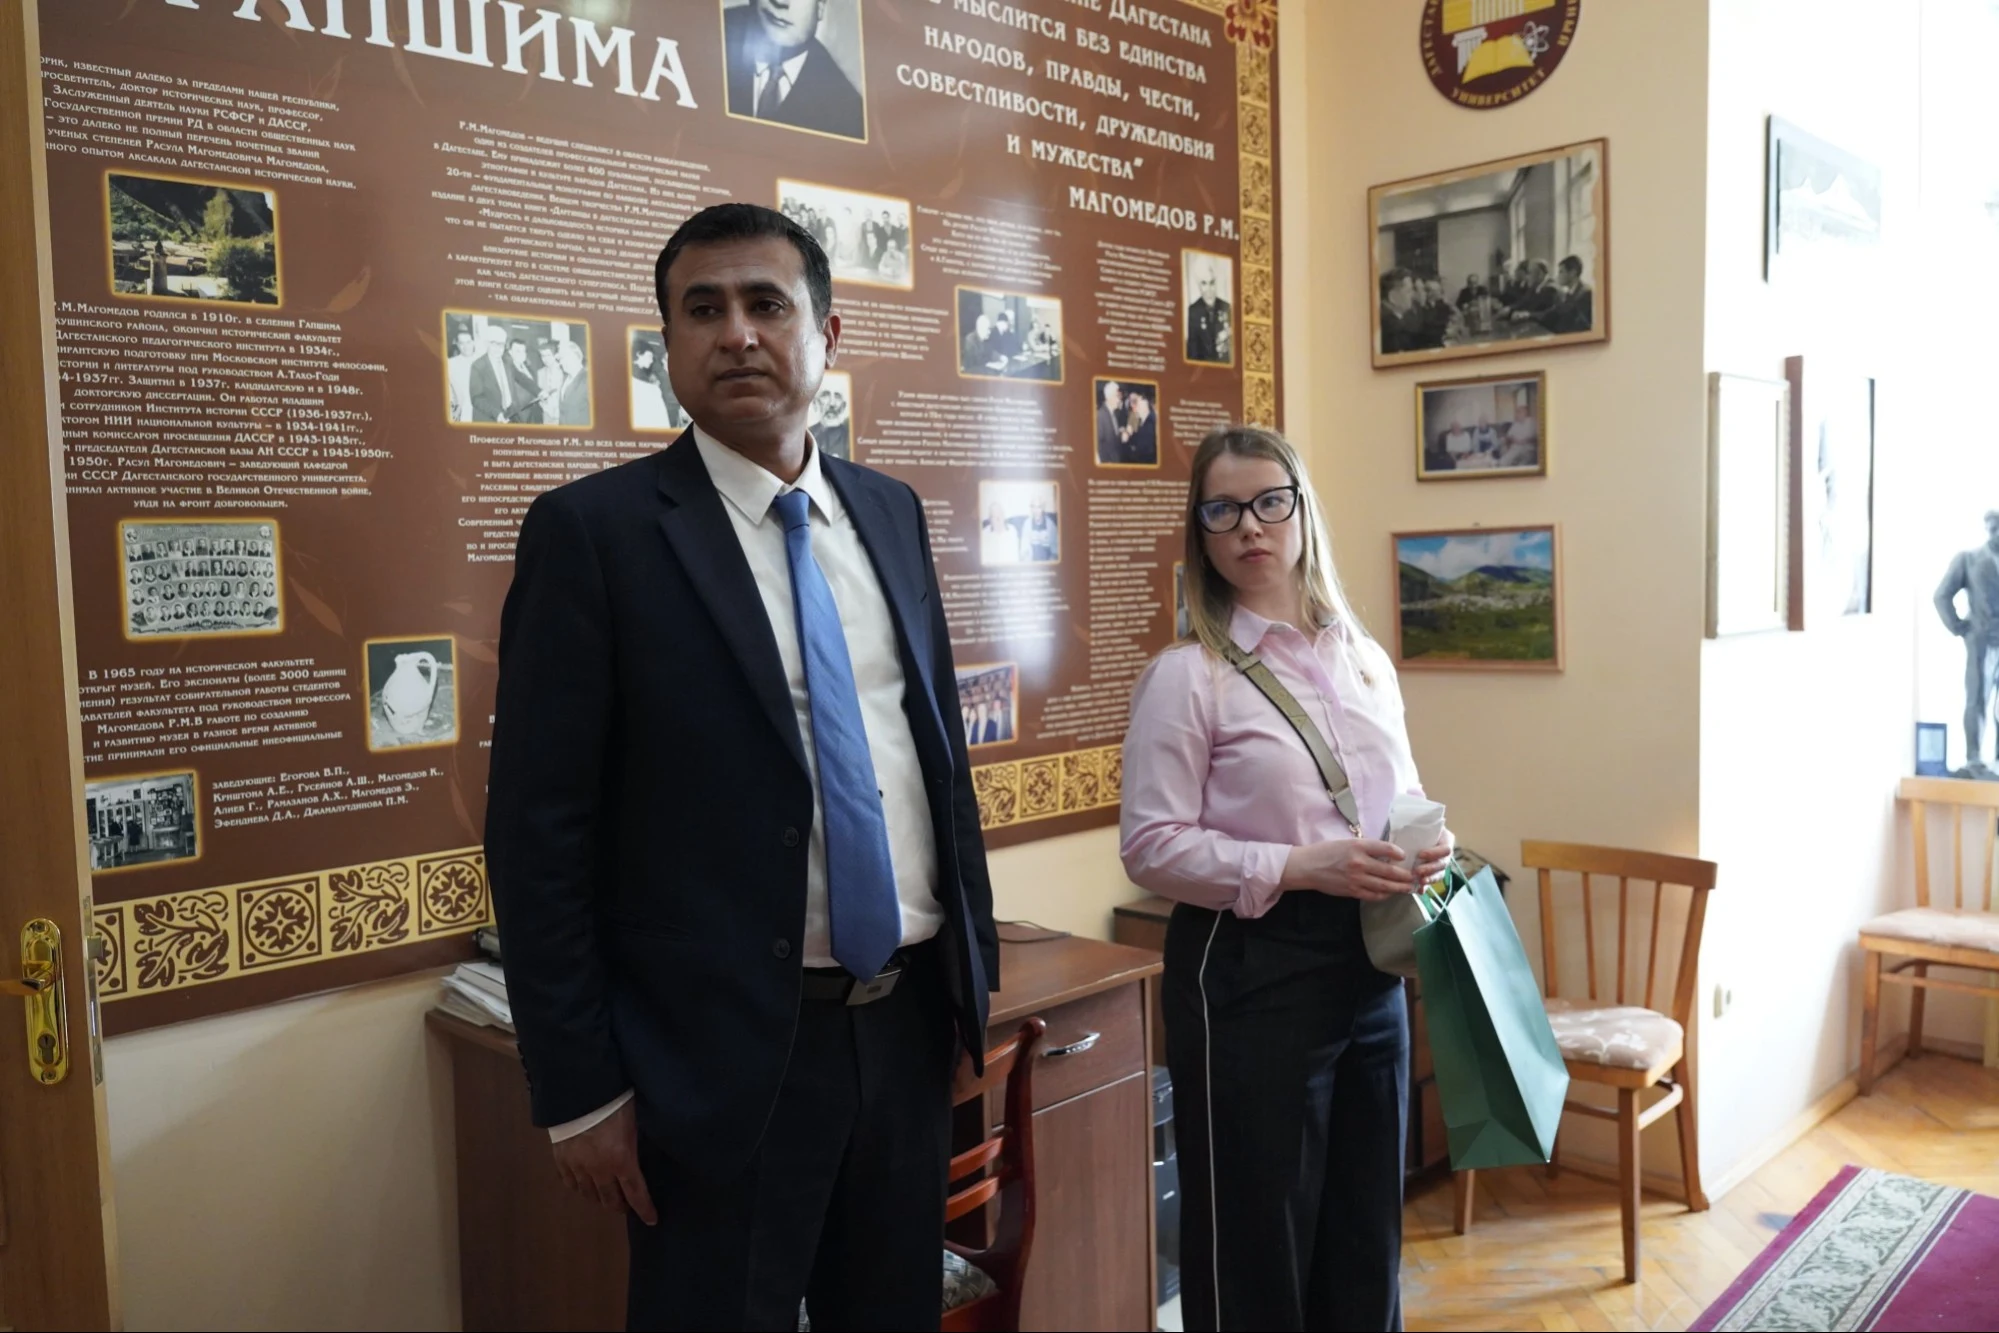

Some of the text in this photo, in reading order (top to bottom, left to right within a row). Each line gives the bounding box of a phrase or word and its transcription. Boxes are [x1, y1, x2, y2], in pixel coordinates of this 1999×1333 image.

[924, 26, 1200, 121] НАРОДОВ, ПРАВДЫ, ЧЕСТИ,
[1077, 28, 1110, 54] БЕЗ
[1119, 41, 1207, 84] ЕДИНСТВА
[897, 64, 1215, 161] СОВЕСТЛИВОСТИ, ДРУЖЕЛЮБИЯ
[1006, 133, 1020, 154] И
[1068, 186, 1240, 241] МАГОМЕДОВ Р.М.
